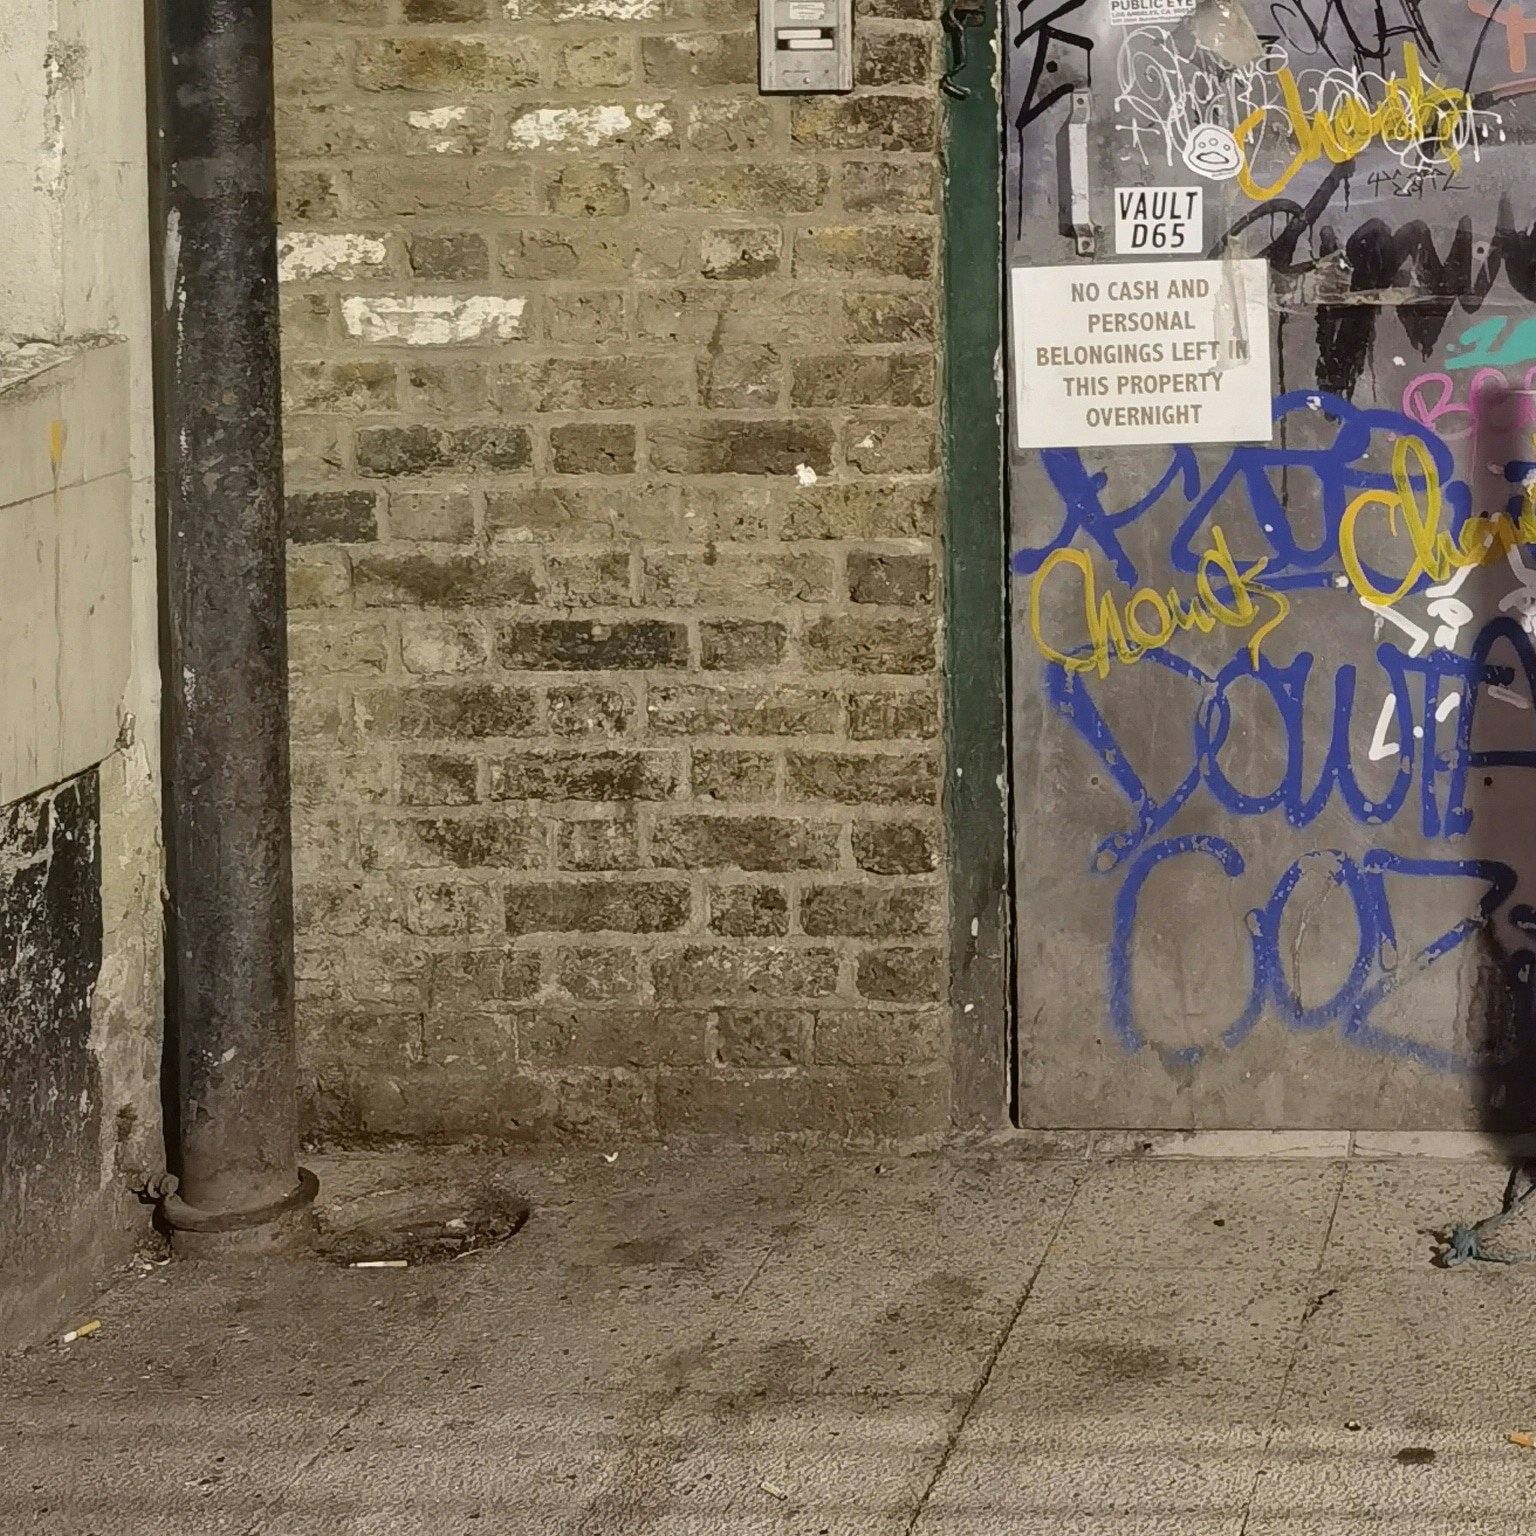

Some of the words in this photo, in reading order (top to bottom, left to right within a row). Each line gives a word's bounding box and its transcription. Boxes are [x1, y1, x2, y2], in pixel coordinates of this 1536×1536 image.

[1119, 190, 1199, 221] VAULT
[1131, 222, 1186, 249] D65
[1070, 282, 1100, 302] NO
[1107, 280, 1160, 301] CASH
[1167, 278, 1210, 299] AND
[1088, 312, 1196, 334] PERSONAL
[1036, 343, 1165, 367] BELONGINGS
[1172, 341, 1219, 362] LEFT
[1228, 339, 1248, 360] IN
[1063, 375, 1110, 397] THIS
[1116, 371, 1224, 396] PROPERTY
[1086, 404, 1203, 428] OVERNIGHT
